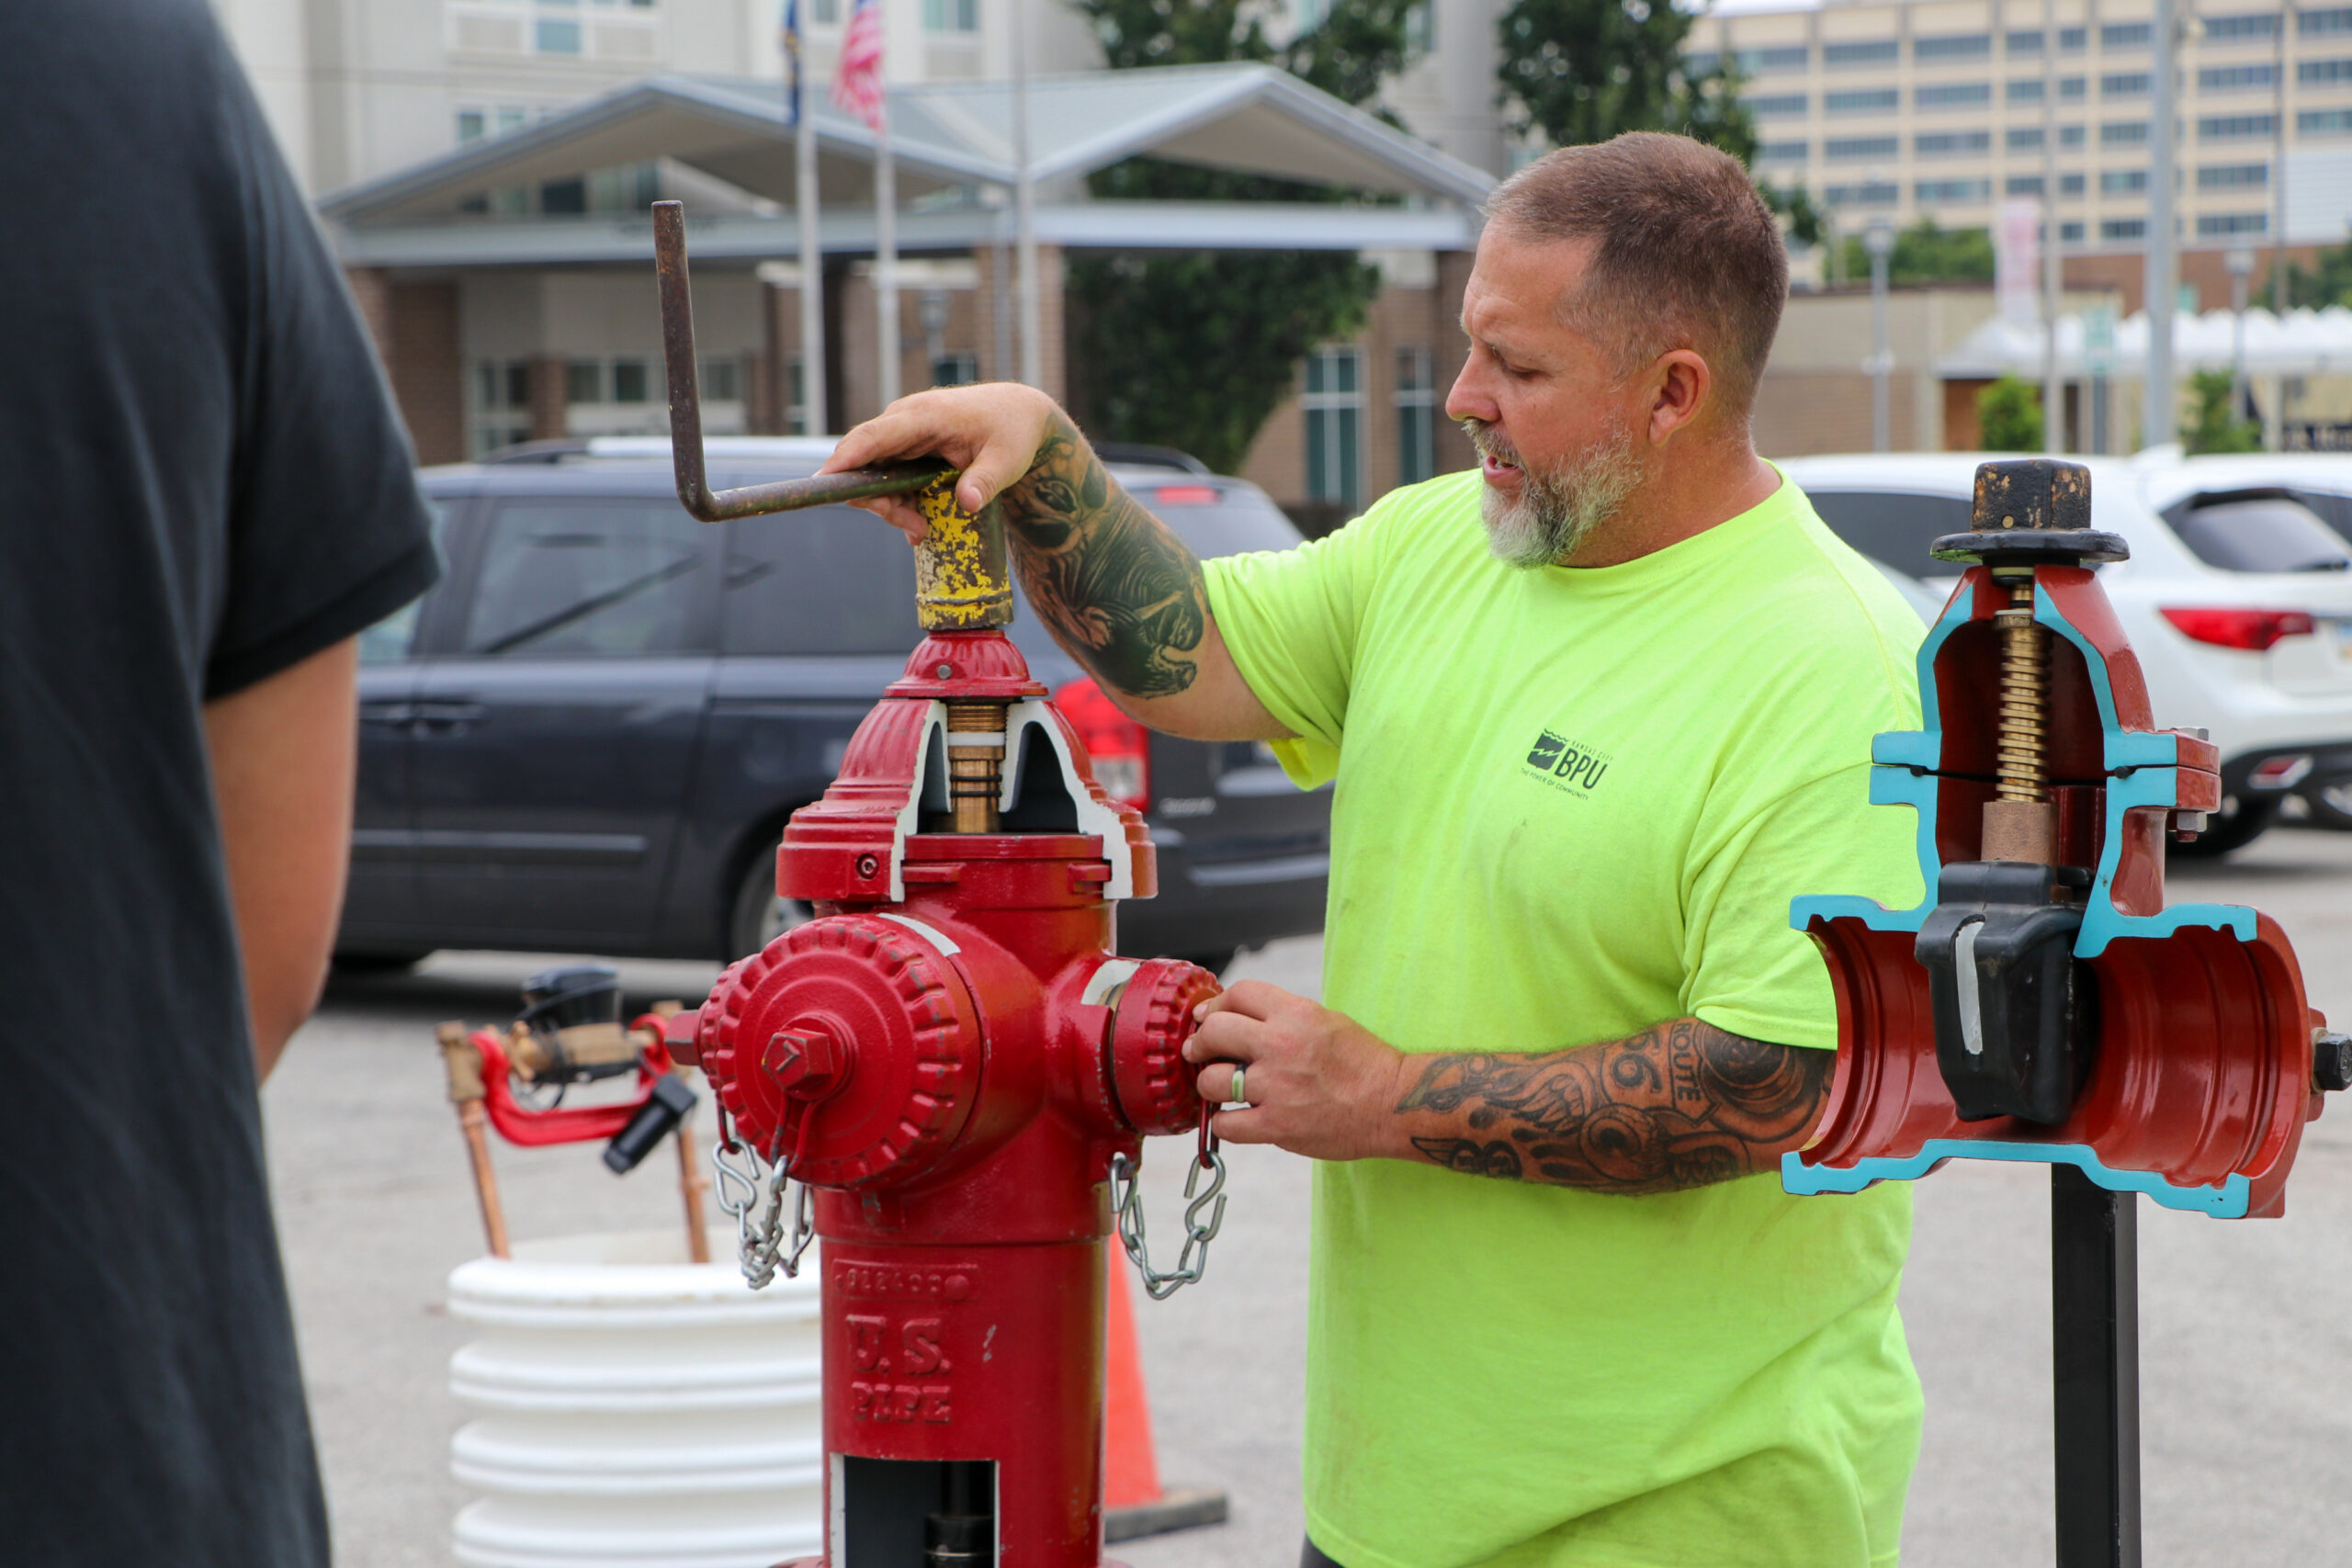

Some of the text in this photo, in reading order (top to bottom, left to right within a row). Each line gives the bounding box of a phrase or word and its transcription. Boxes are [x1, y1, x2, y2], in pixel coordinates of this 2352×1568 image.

[1529, 772, 1547, 784] POWER
[1555, 783, 1589, 801] COMMUNITY
[1554, 748, 1609, 790] BPU
[1673, 1022, 1702, 1101] ROUTE
[851, 1381, 952, 1424] PIPE
